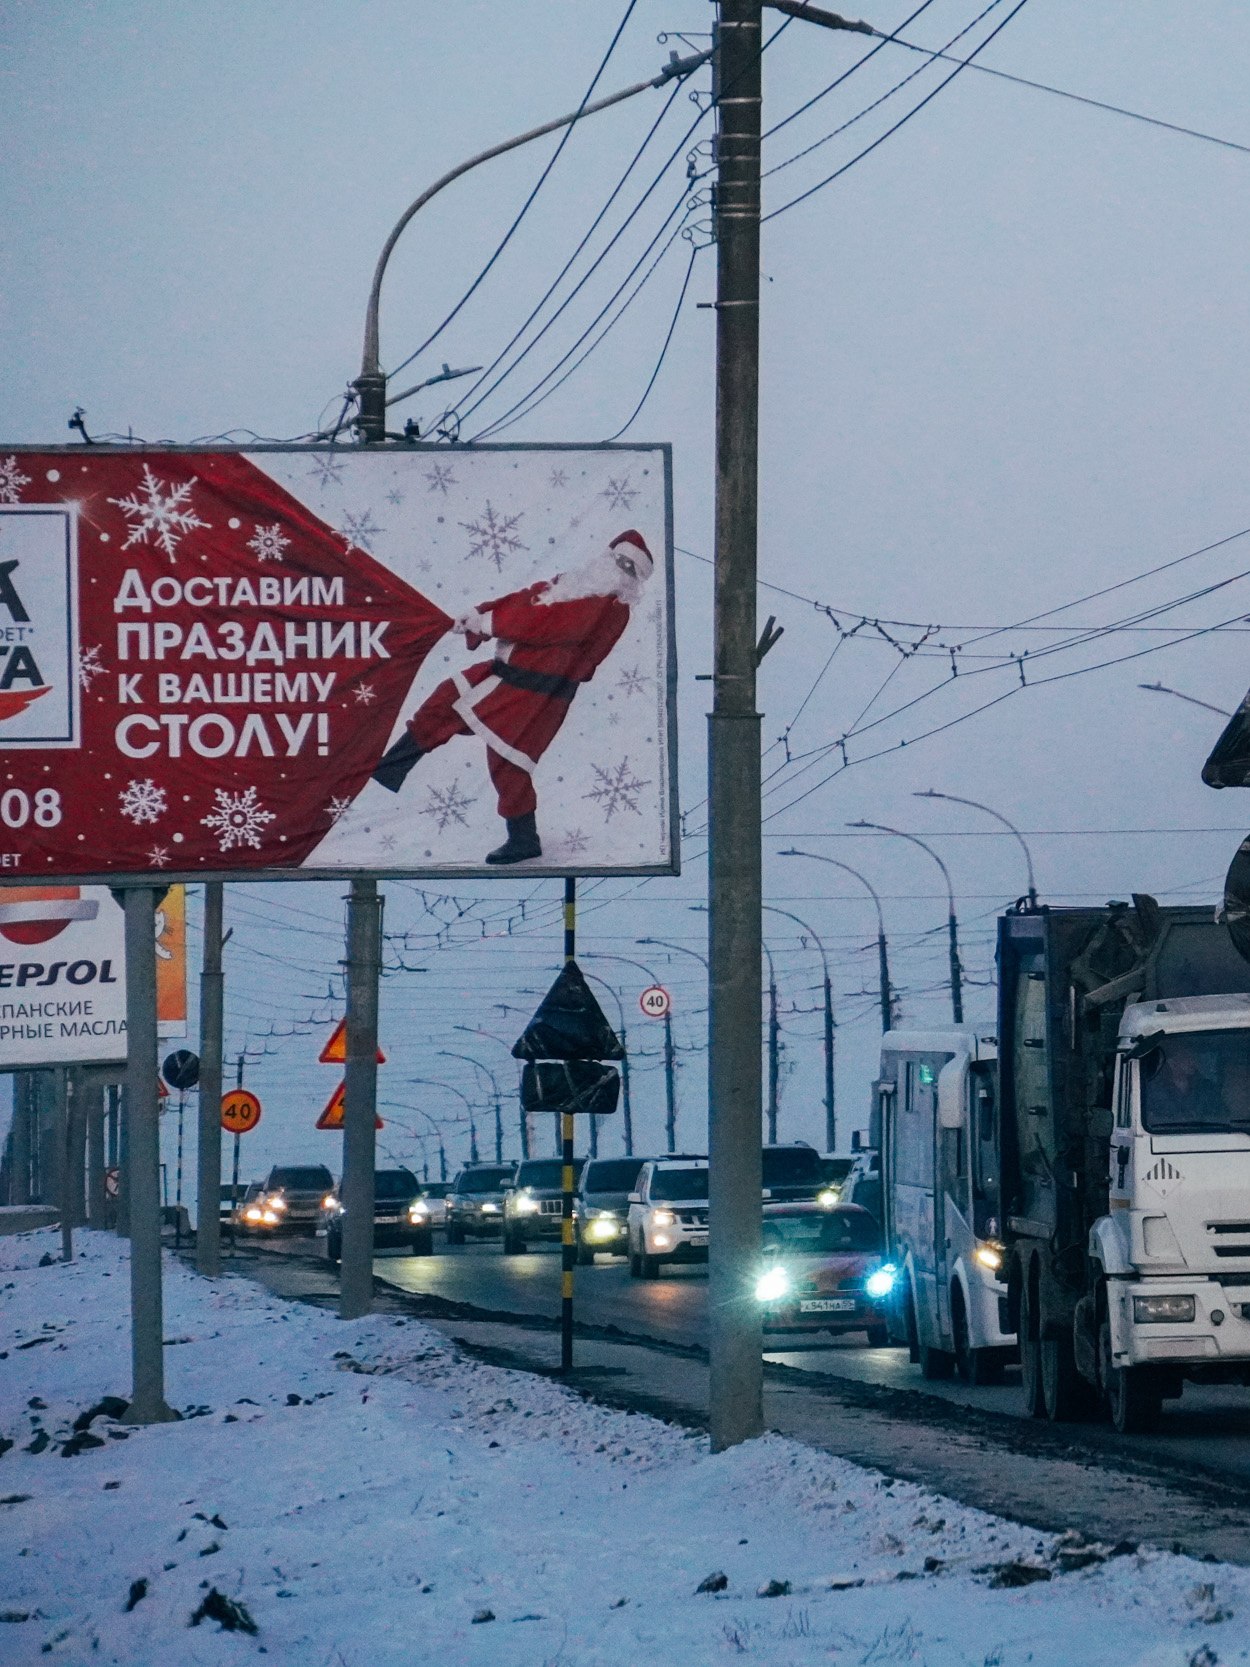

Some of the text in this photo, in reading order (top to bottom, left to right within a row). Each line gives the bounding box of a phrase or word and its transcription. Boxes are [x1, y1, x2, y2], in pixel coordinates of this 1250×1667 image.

[114, 568, 344, 613] ДОСТАВИМ
[117, 620, 391, 666] ПРАЗДНИК
[118, 672, 336, 703] К ВАШЕМУ
[115, 713, 329, 758] СТОЛУ!
[1, 788, 62, 828] 08
[0, 853, 22, 867] ЕТ
[0, 1001, 93, 1018] ПАНСКИЕ
[647, 996, 663, 1007] 40
[0, 1020, 127, 1039] РНЫЕ МАСЛА
[225, 1104, 250, 1119] 40
